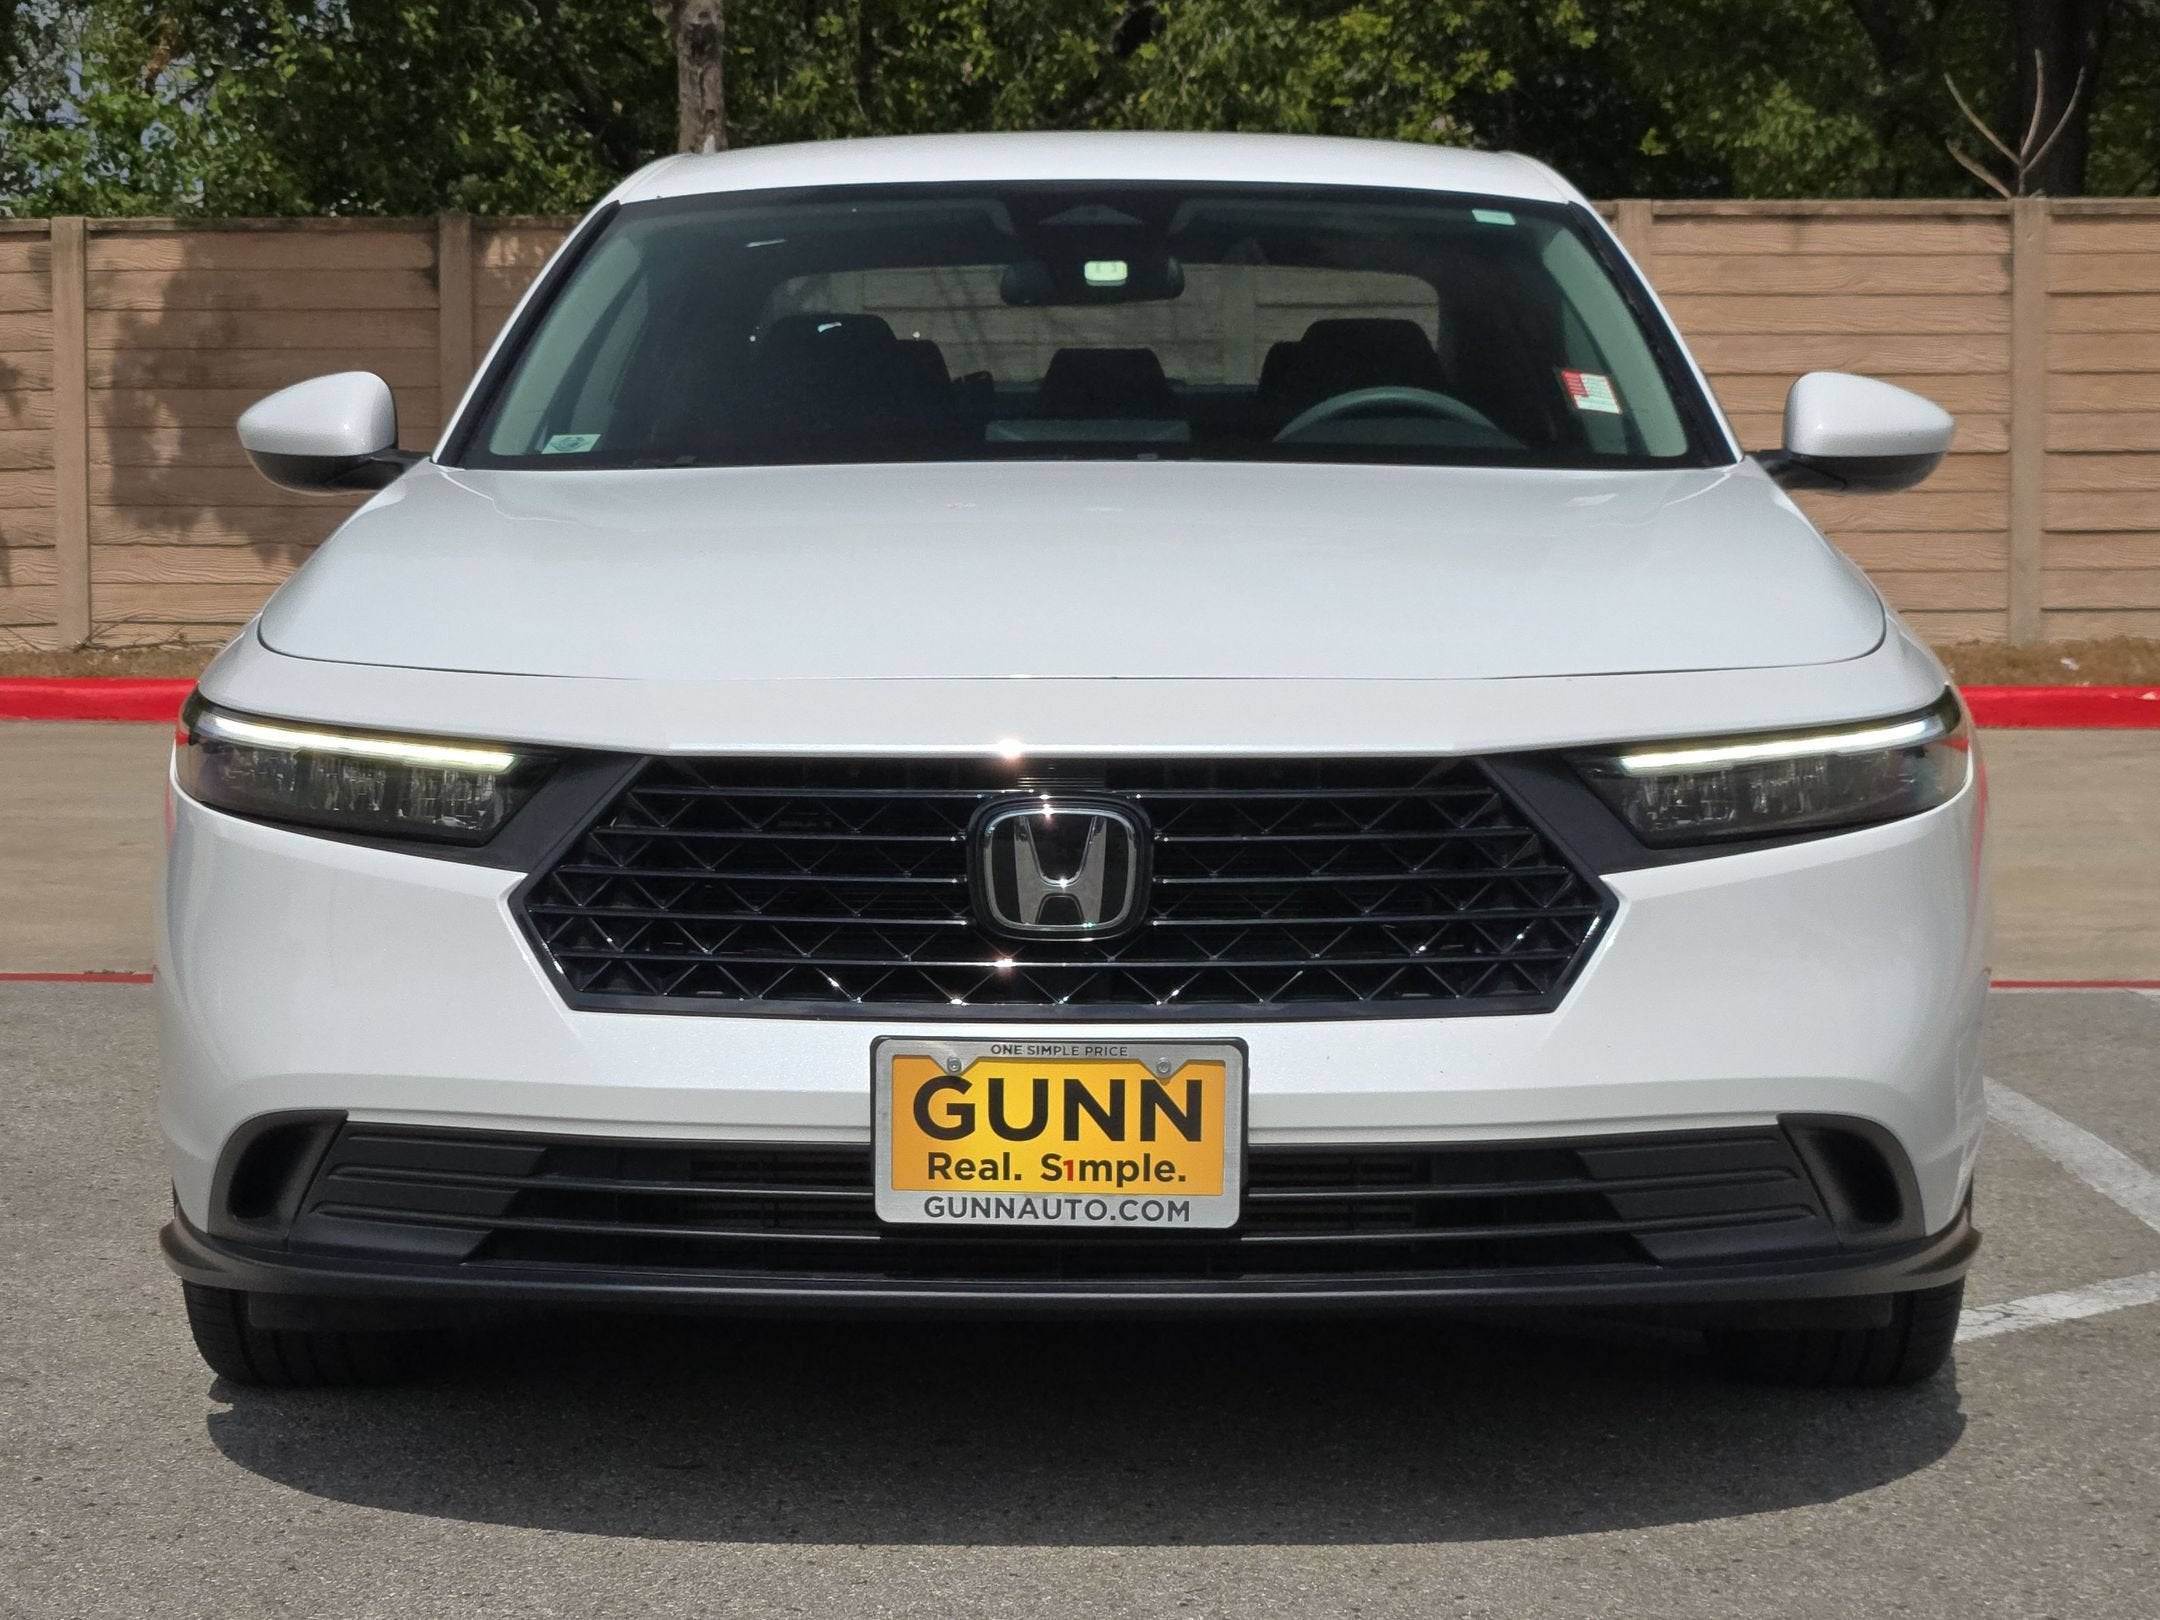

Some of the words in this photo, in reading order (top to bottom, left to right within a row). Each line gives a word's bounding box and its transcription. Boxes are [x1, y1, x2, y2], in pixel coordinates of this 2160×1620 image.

[990, 1044, 1023, 1056] ONE
[1027, 1044, 1081, 1057] SIMPLE
[1085, 1045, 1129, 1057] PRICE
[913, 1075, 1203, 1142] GUNN
[927, 1152, 1022, 1181] Real.
[1040, 1153, 1187, 1187] S1mple.
[923, 1196, 1190, 1222] GUNNAUTO.COM
